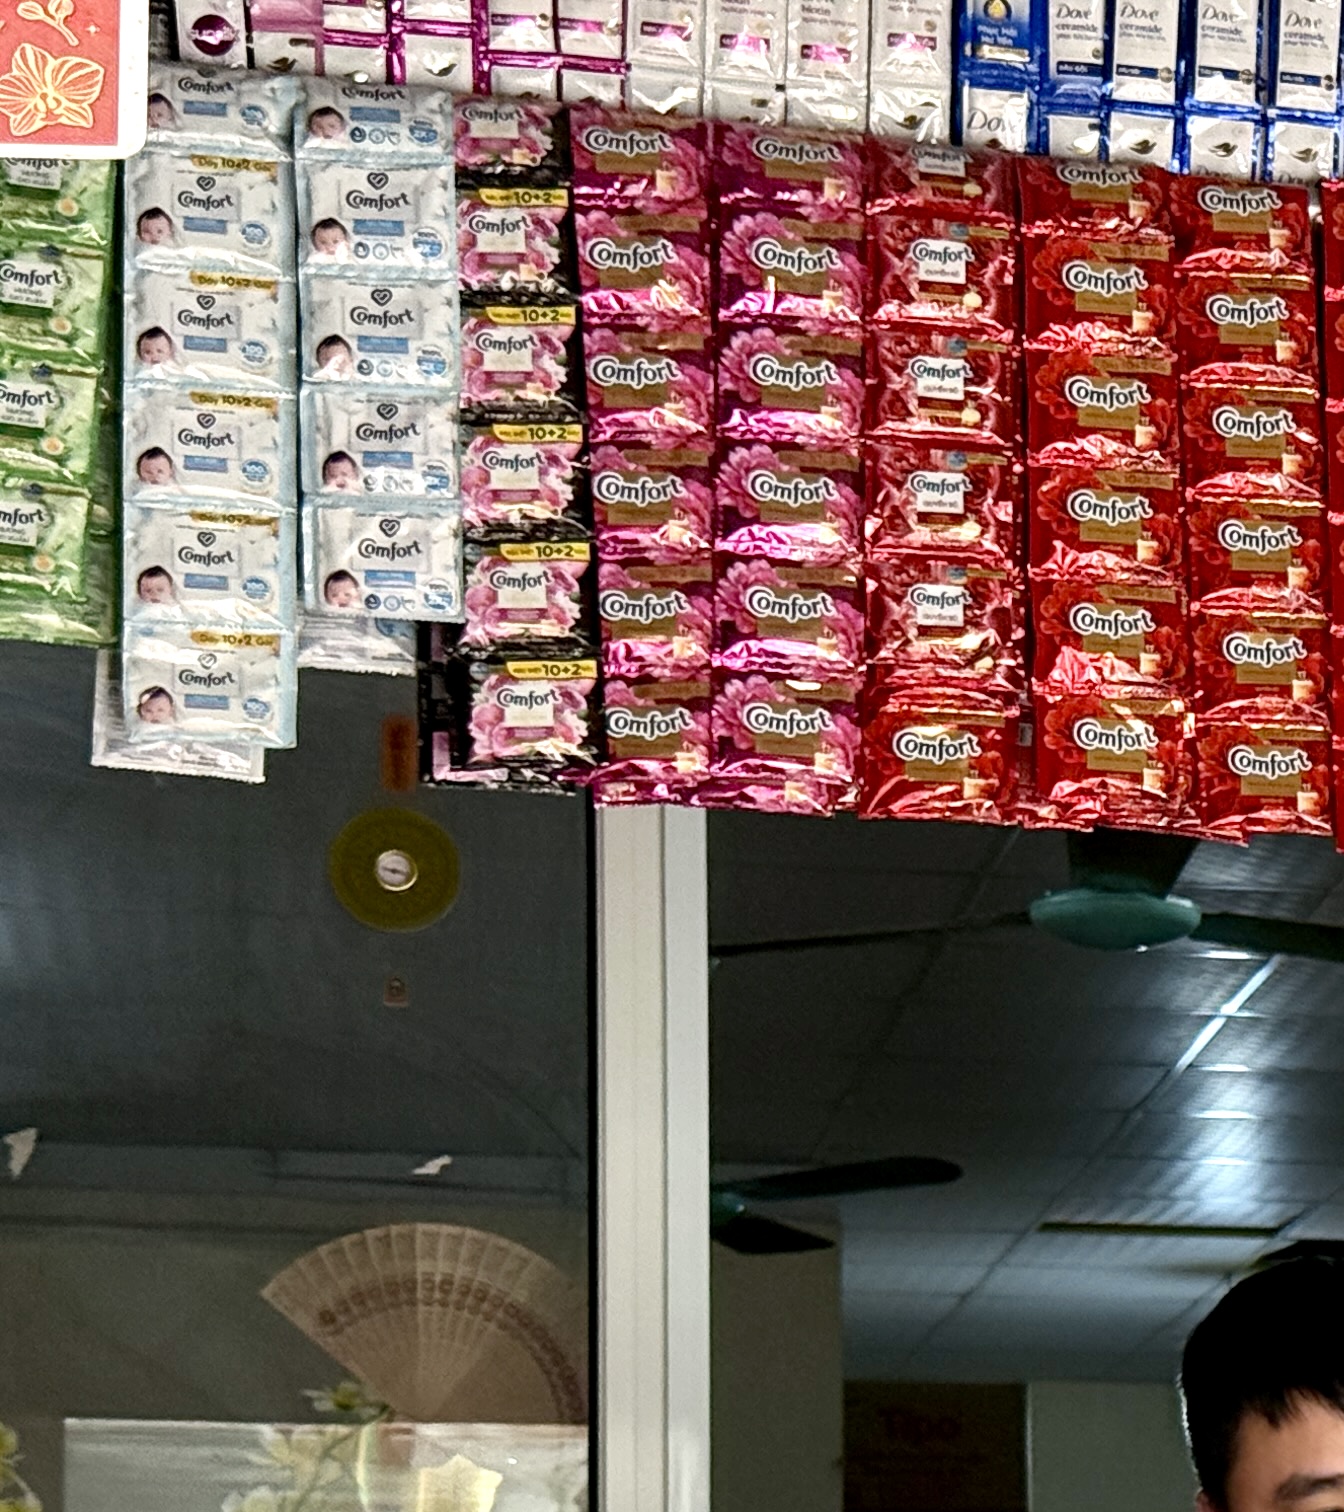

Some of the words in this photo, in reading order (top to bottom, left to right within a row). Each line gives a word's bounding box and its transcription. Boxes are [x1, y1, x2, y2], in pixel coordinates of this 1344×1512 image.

[1285, 12, 1322, 28] Dove
[178, 190, 234, 211] Comfort
[469, 215, 530, 238] Comfort
[589, 238, 675, 269] Comfort
[912, 238, 975, 262] Comfort
[1064, 261, 1147, 292] Comfort
[1206, 294, 1289, 323] Comfort
[752, 356, 836, 387] Comfort
[356, 420, 420, 444] Comfort
[607, 705, 691, 736] Comfort
